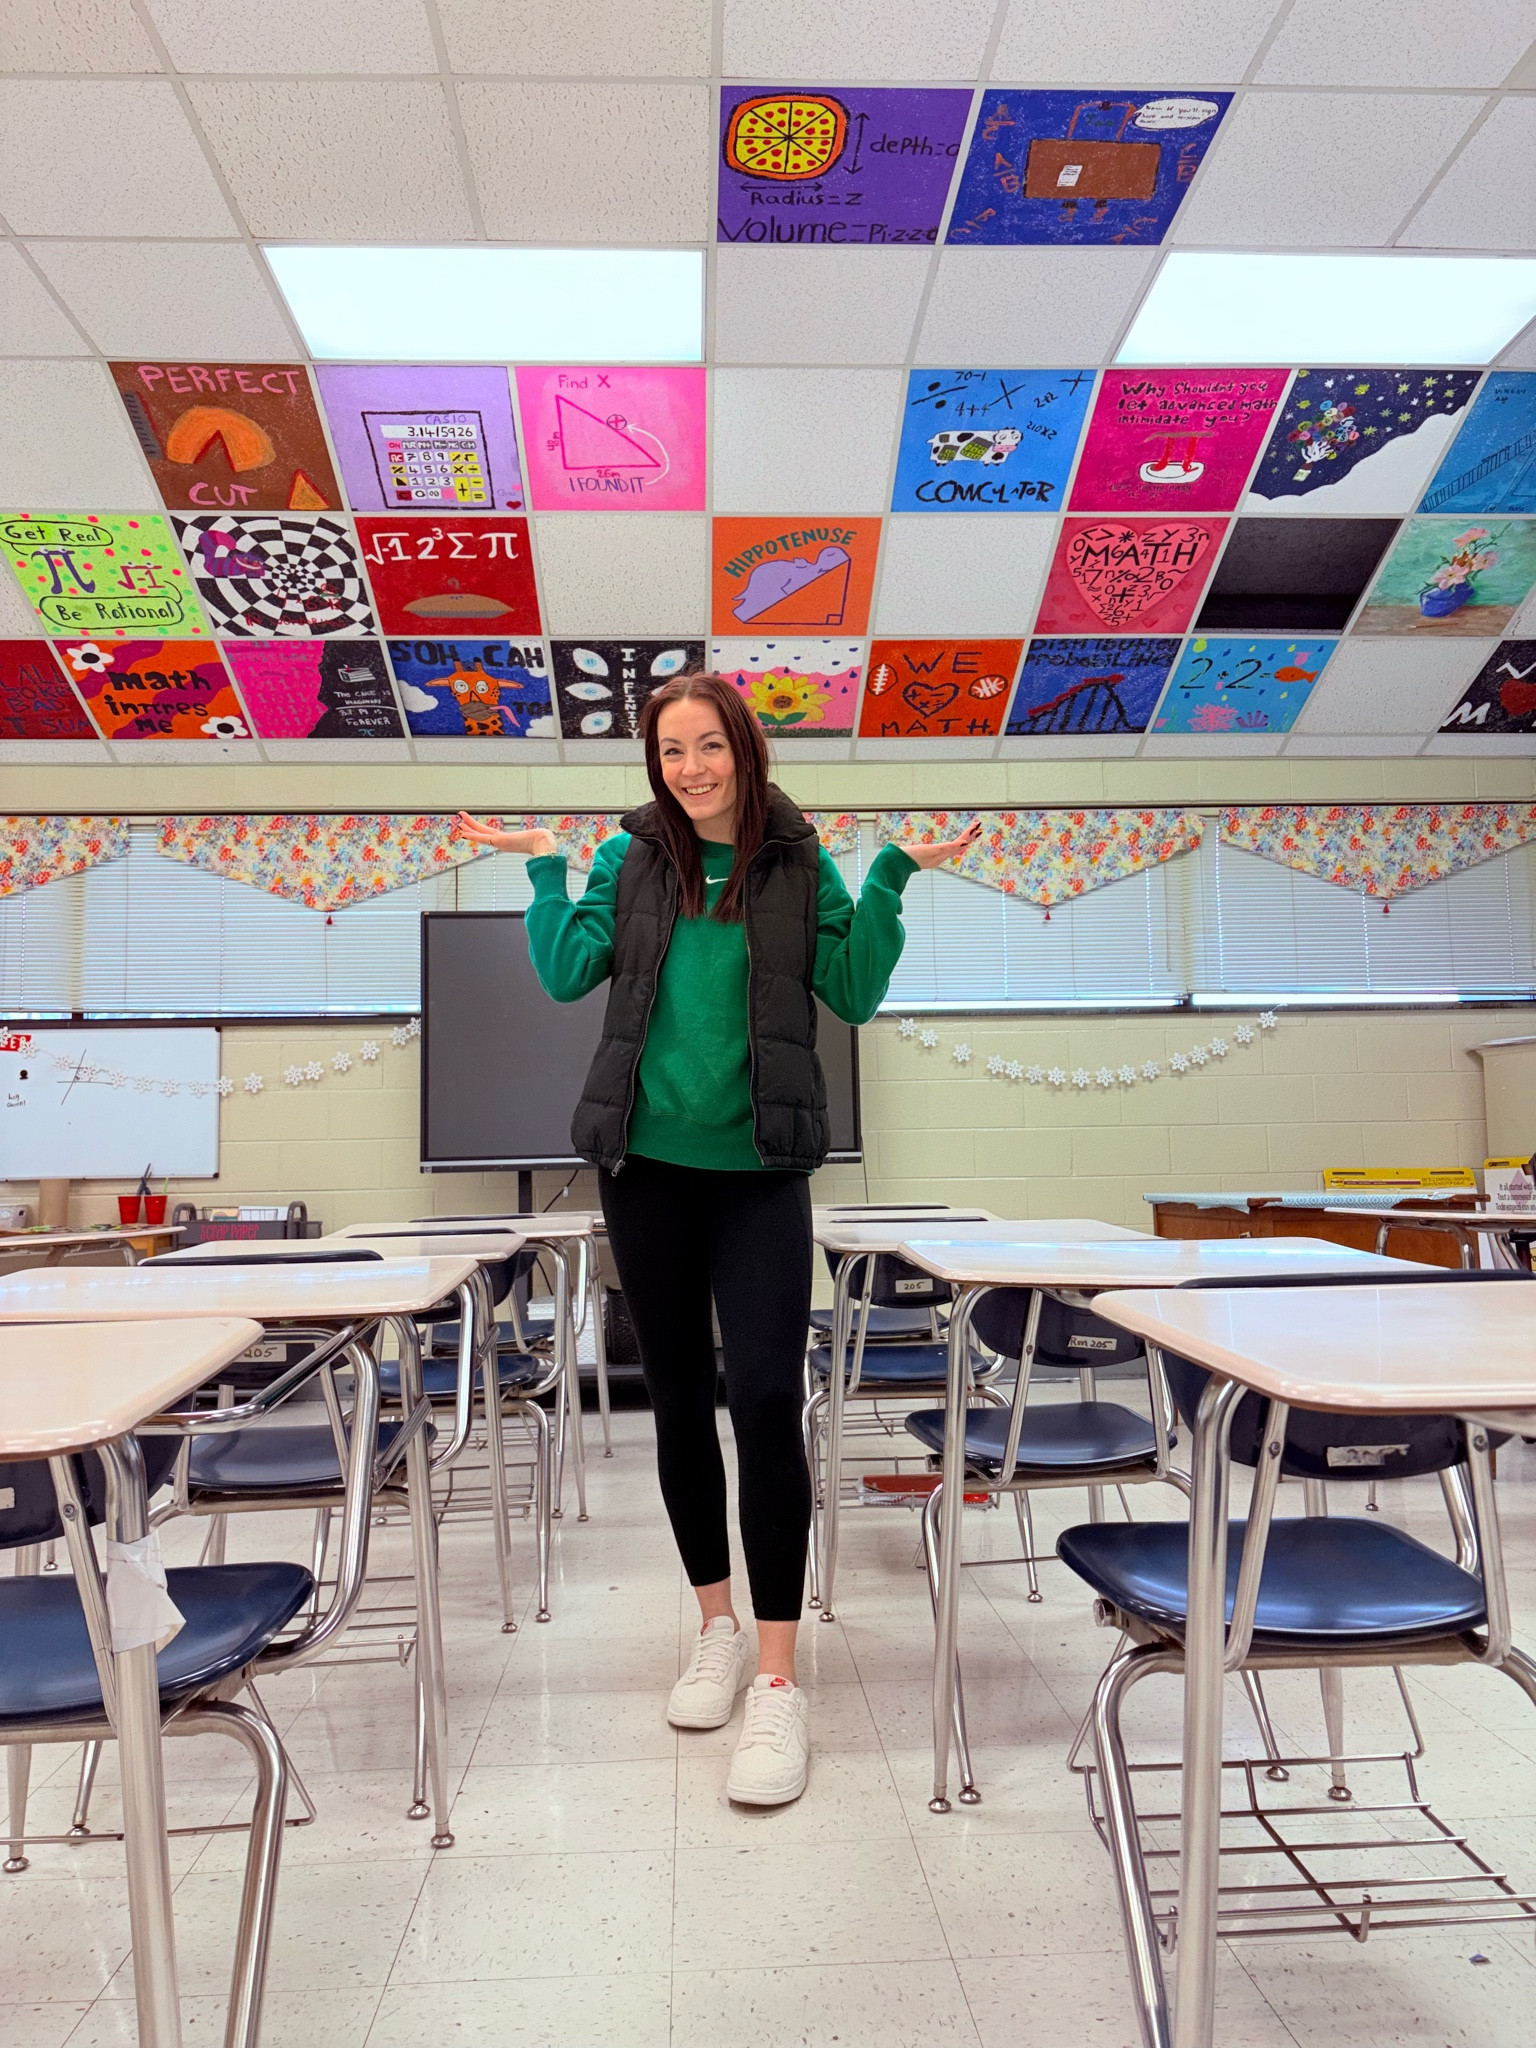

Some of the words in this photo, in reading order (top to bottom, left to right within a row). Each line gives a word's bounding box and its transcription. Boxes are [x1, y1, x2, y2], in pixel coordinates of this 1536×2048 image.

[138, 366, 299, 394] PERFECT
[558, 374, 588, 389] Find
[1122, 382, 1165, 397] Why
[1240, 382, 1268, 395] you
[955, 401, 991, 417] 4+4
[1118, 398, 1148, 410] let
[1158, 399, 1236, 411] advanced
[1239, 398, 1278, 410] math
[425, 414, 467, 424] CASIO
[1118, 413, 1189, 424] intimidate
[1204, 412, 1250, 428] you?
[407, 426, 473, 438] 3.1415926
[423, 452, 431, 460] 8
[437, 452, 444, 460] 9
[409, 465, 418, 474] 4
[424, 465, 432, 473] 5
[441, 464, 448, 473] 6
[444, 477, 451, 485] 3
[577, 477, 629, 492] FOUND
[189, 482, 258, 506] CUT
[5, 525, 45, 540] Get
[59, 528, 101, 543] Real
[723, 527, 857, 579] HIPPOTENUSE
[56, 604, 83, 620] Be
[96, 602, 174, 620] Rational
[391, 640, 461, 665] SOH
[483, 644, 545, 668] CAH
[903, 651, 983, 674] WE
[107, 670, 211, 691] math
[621, 648, 640, 739] INFINITY
[903, 1281, 925, 1290] 205
[1090, 1340, 1113, 1348] 205
[243, 1346, 278, 1358] 205
